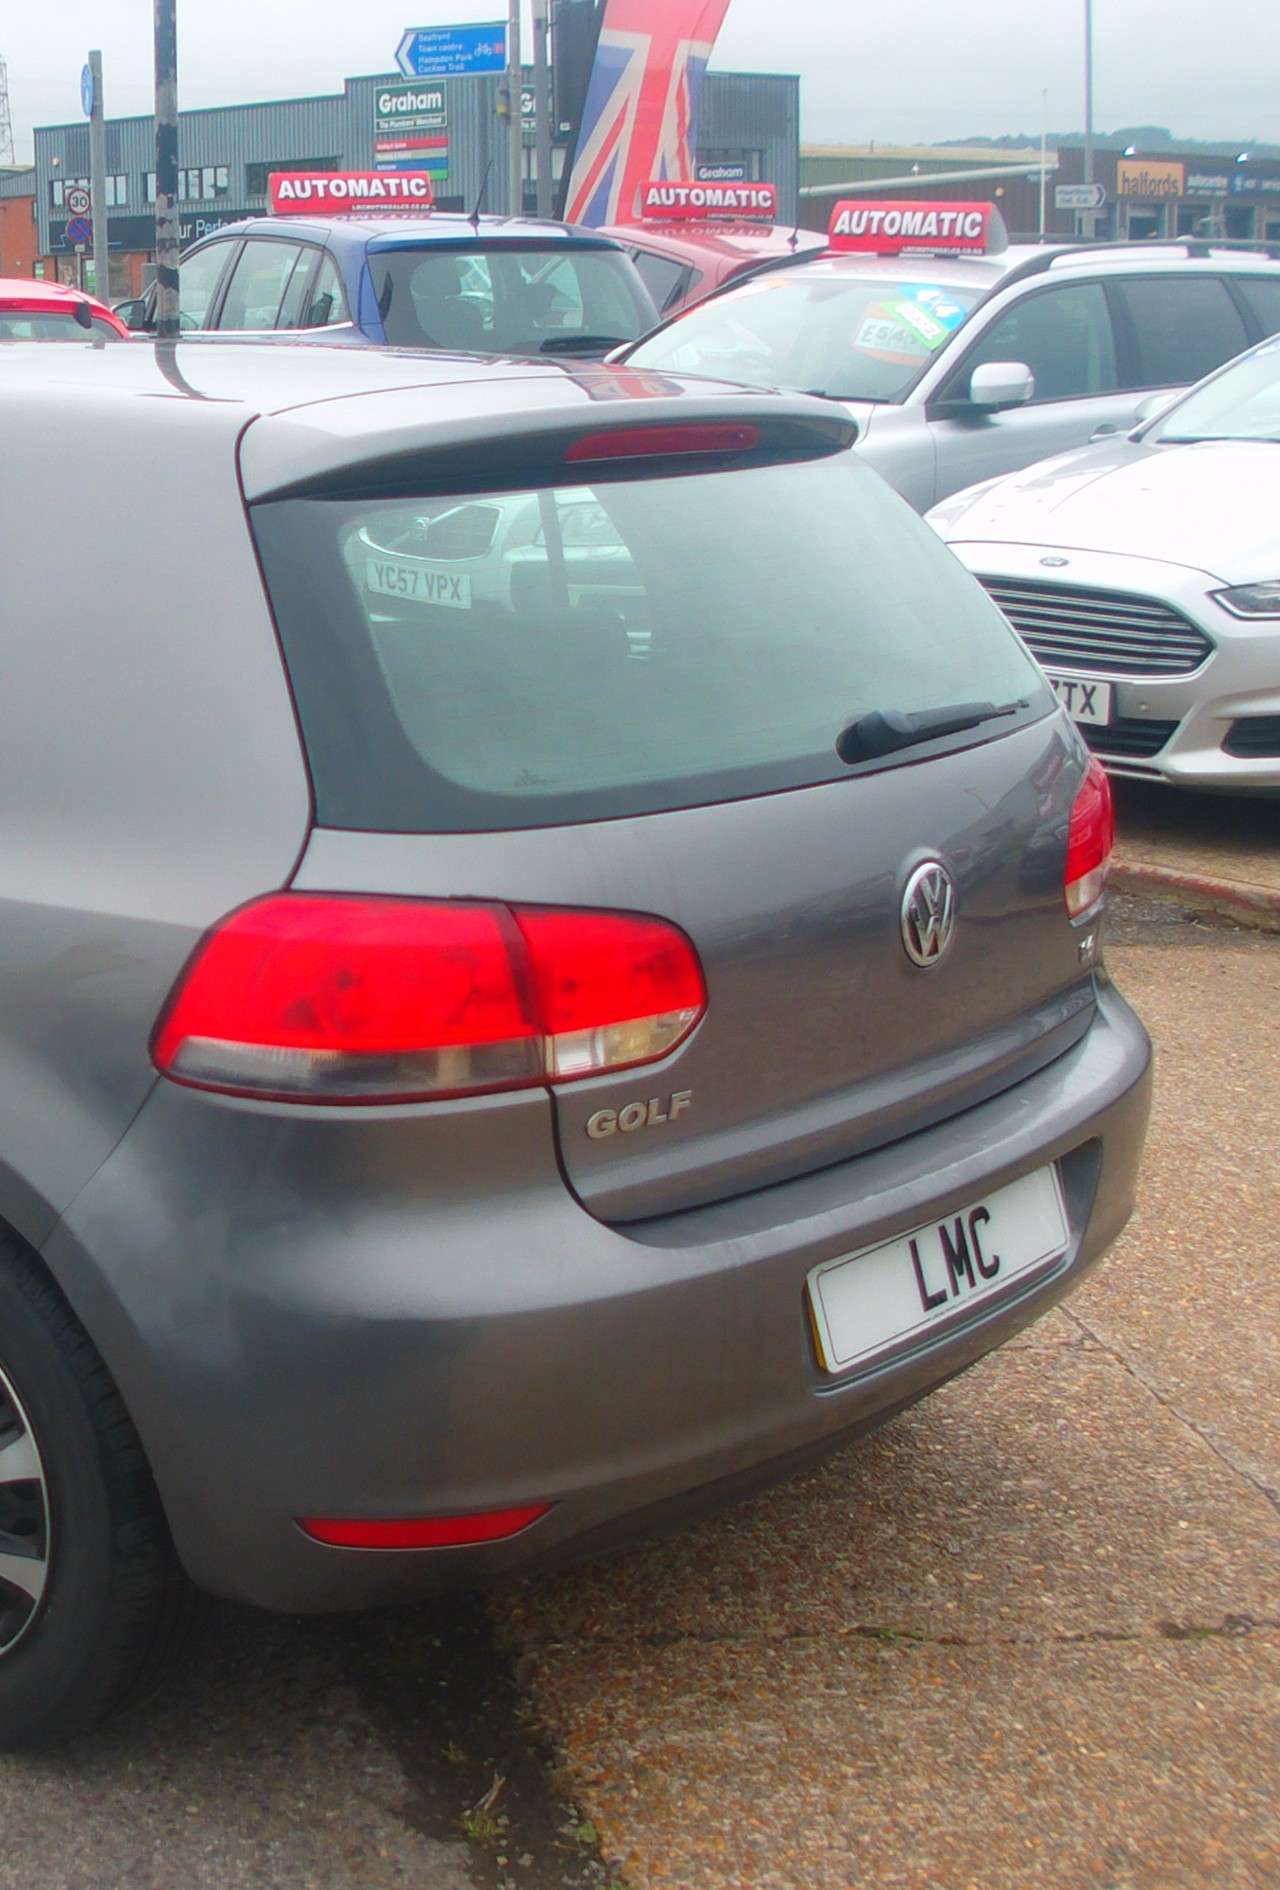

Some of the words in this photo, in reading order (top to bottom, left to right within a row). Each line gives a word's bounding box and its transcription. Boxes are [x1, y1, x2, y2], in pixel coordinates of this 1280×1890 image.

[379, 91, 442, 114] Graham
[699, 167, 744, 180] Graham
[1121, 171, 1180, 196] halfords
[278, 178, 427, 199] AUTOMATIC
[646, 187, 773, 208] AUTOMATIC
[71, 195, 87, 208] 30
[833, 210, 983, 237] AUTOMATIC
[374, 562, 419, 594] YC57
[424, 573, 462, 601] VPX
[585, 1090, 693, 1140] GOLF
[907, 1205, 1002, 1313] LMC
